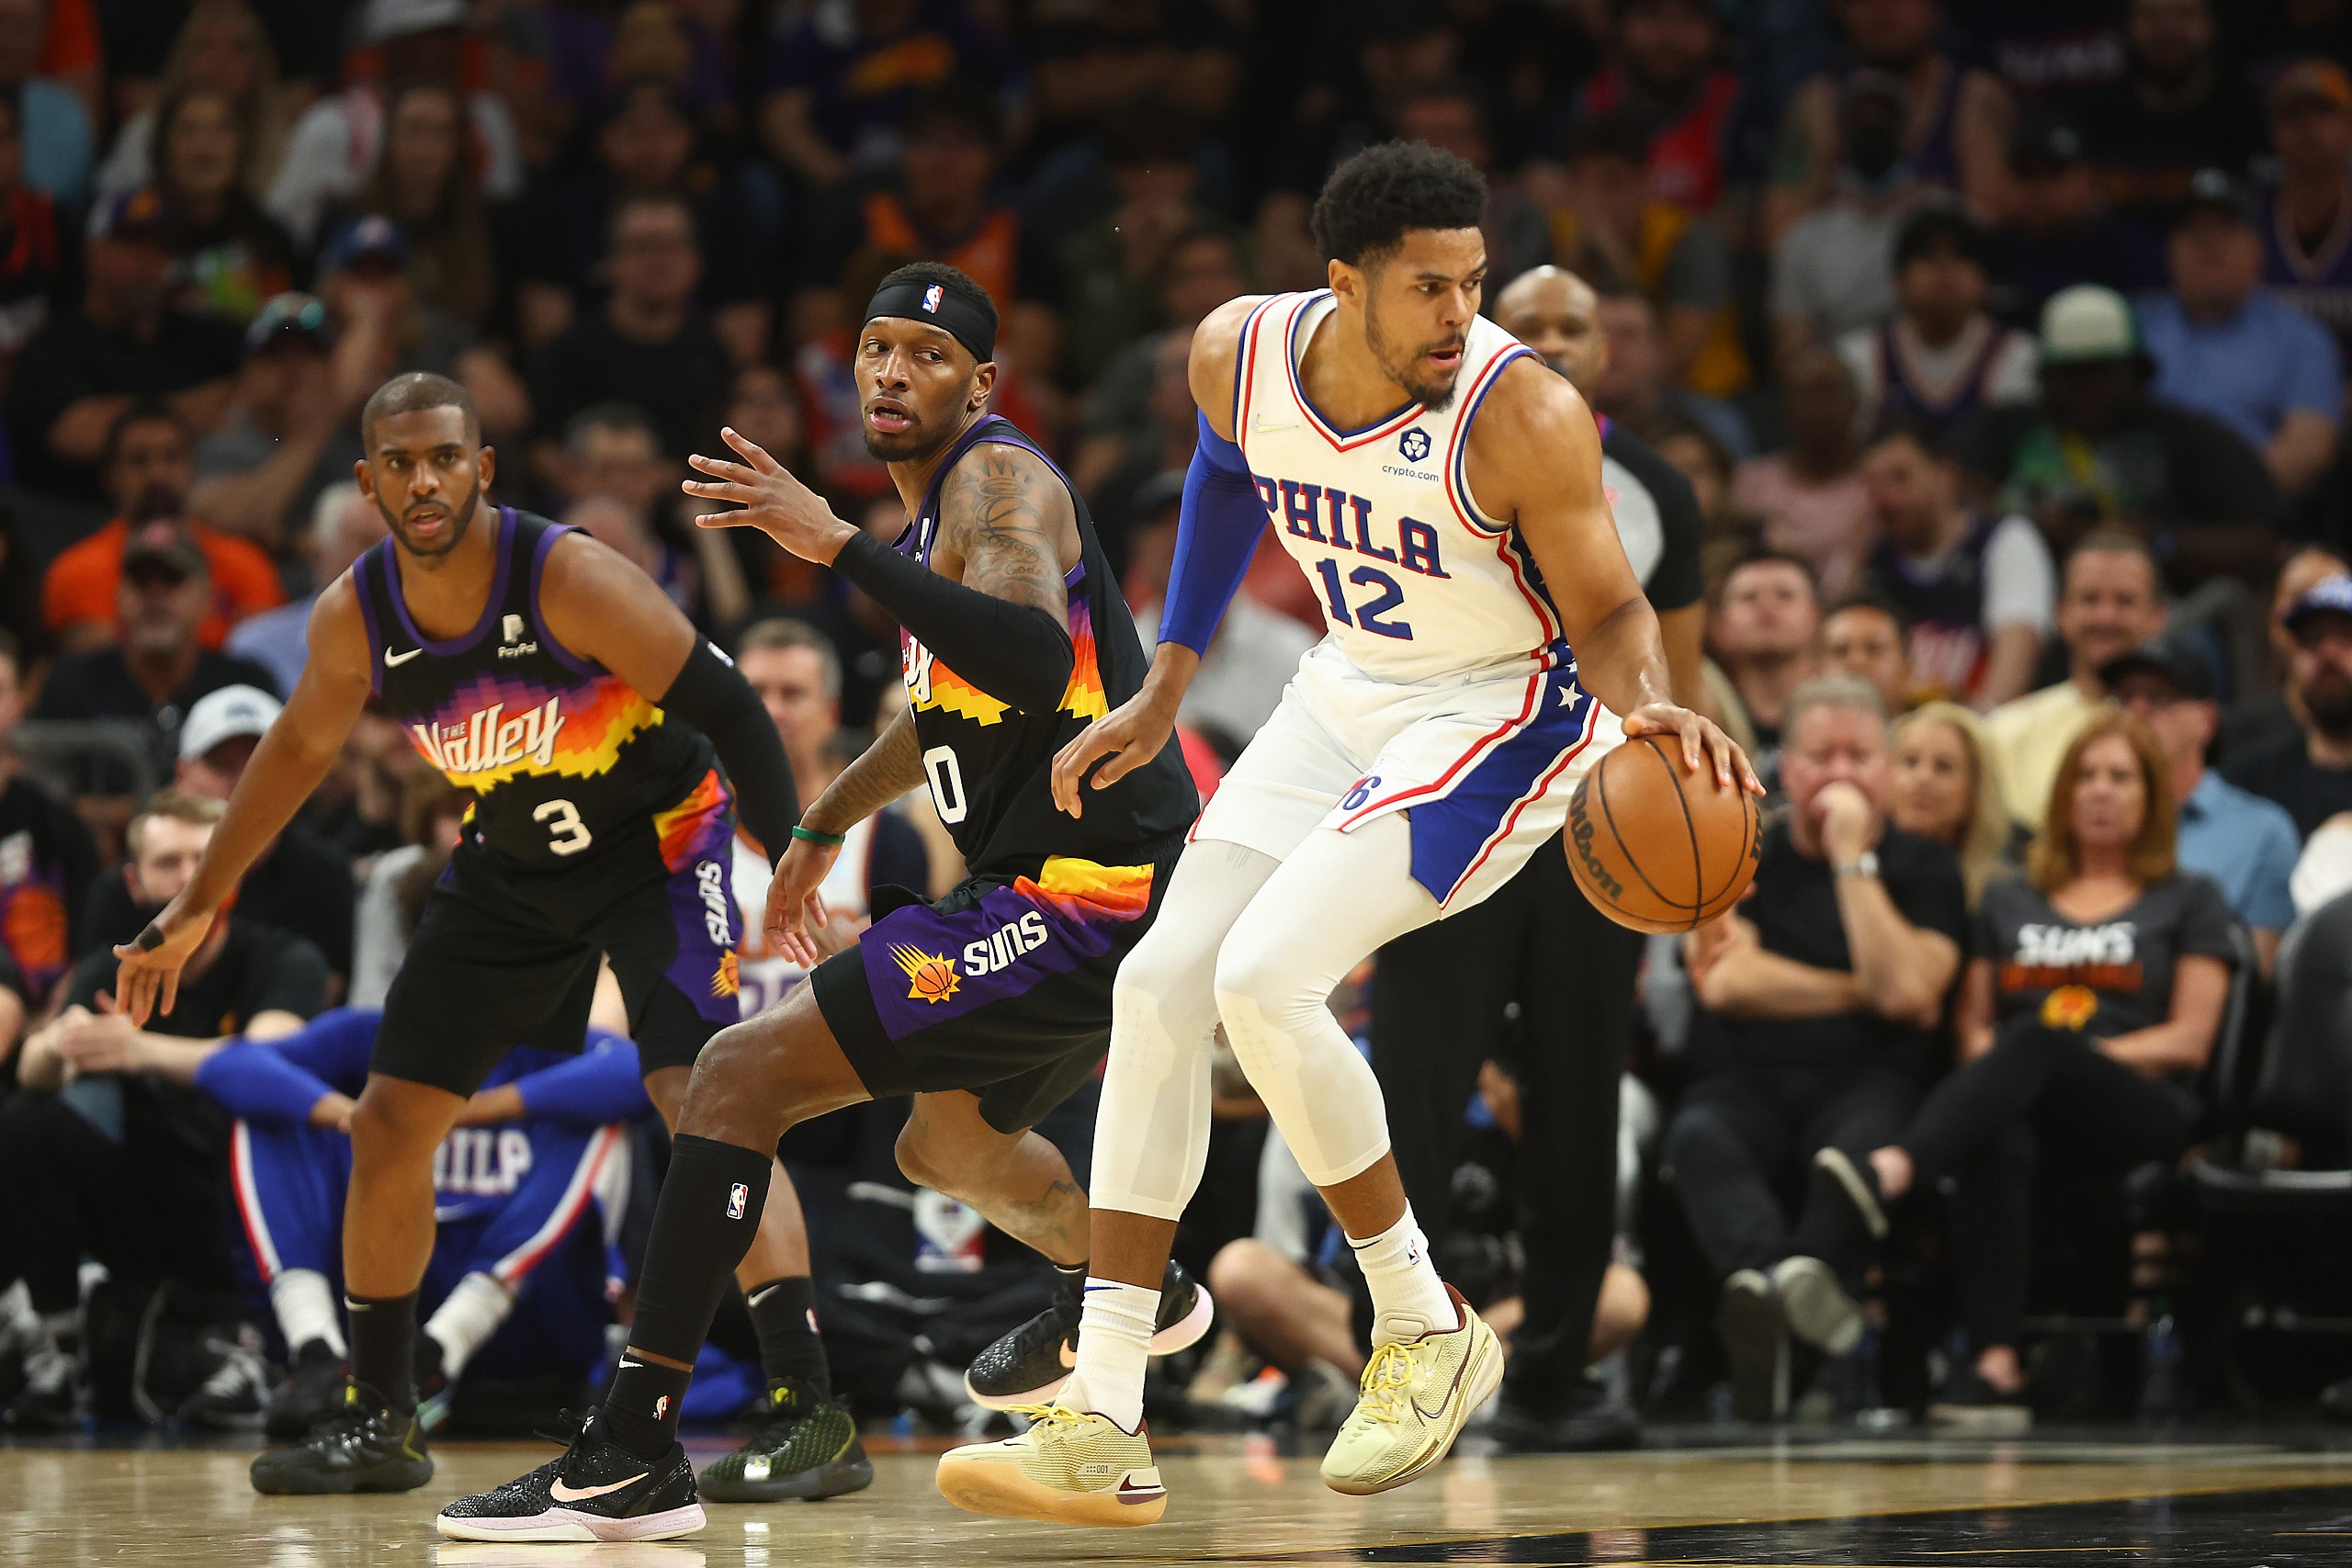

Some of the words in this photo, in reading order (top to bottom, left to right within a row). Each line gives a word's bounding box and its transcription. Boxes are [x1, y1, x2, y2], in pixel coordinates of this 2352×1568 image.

[1382, 464, 1440, 482] crypto.com
[1252, 473, 1453, 580] PHILA
[1316, 558, 1414, 641] 12
[497, 641, 538, 660] PayPal
[412, 696, 567, 773] Valley
[441, 722, 467, 739] THE
[922, 745, 967, 824] 0
[533, 798, 593, 856] 3
[1570, 773, 1623, 902] Wilson
